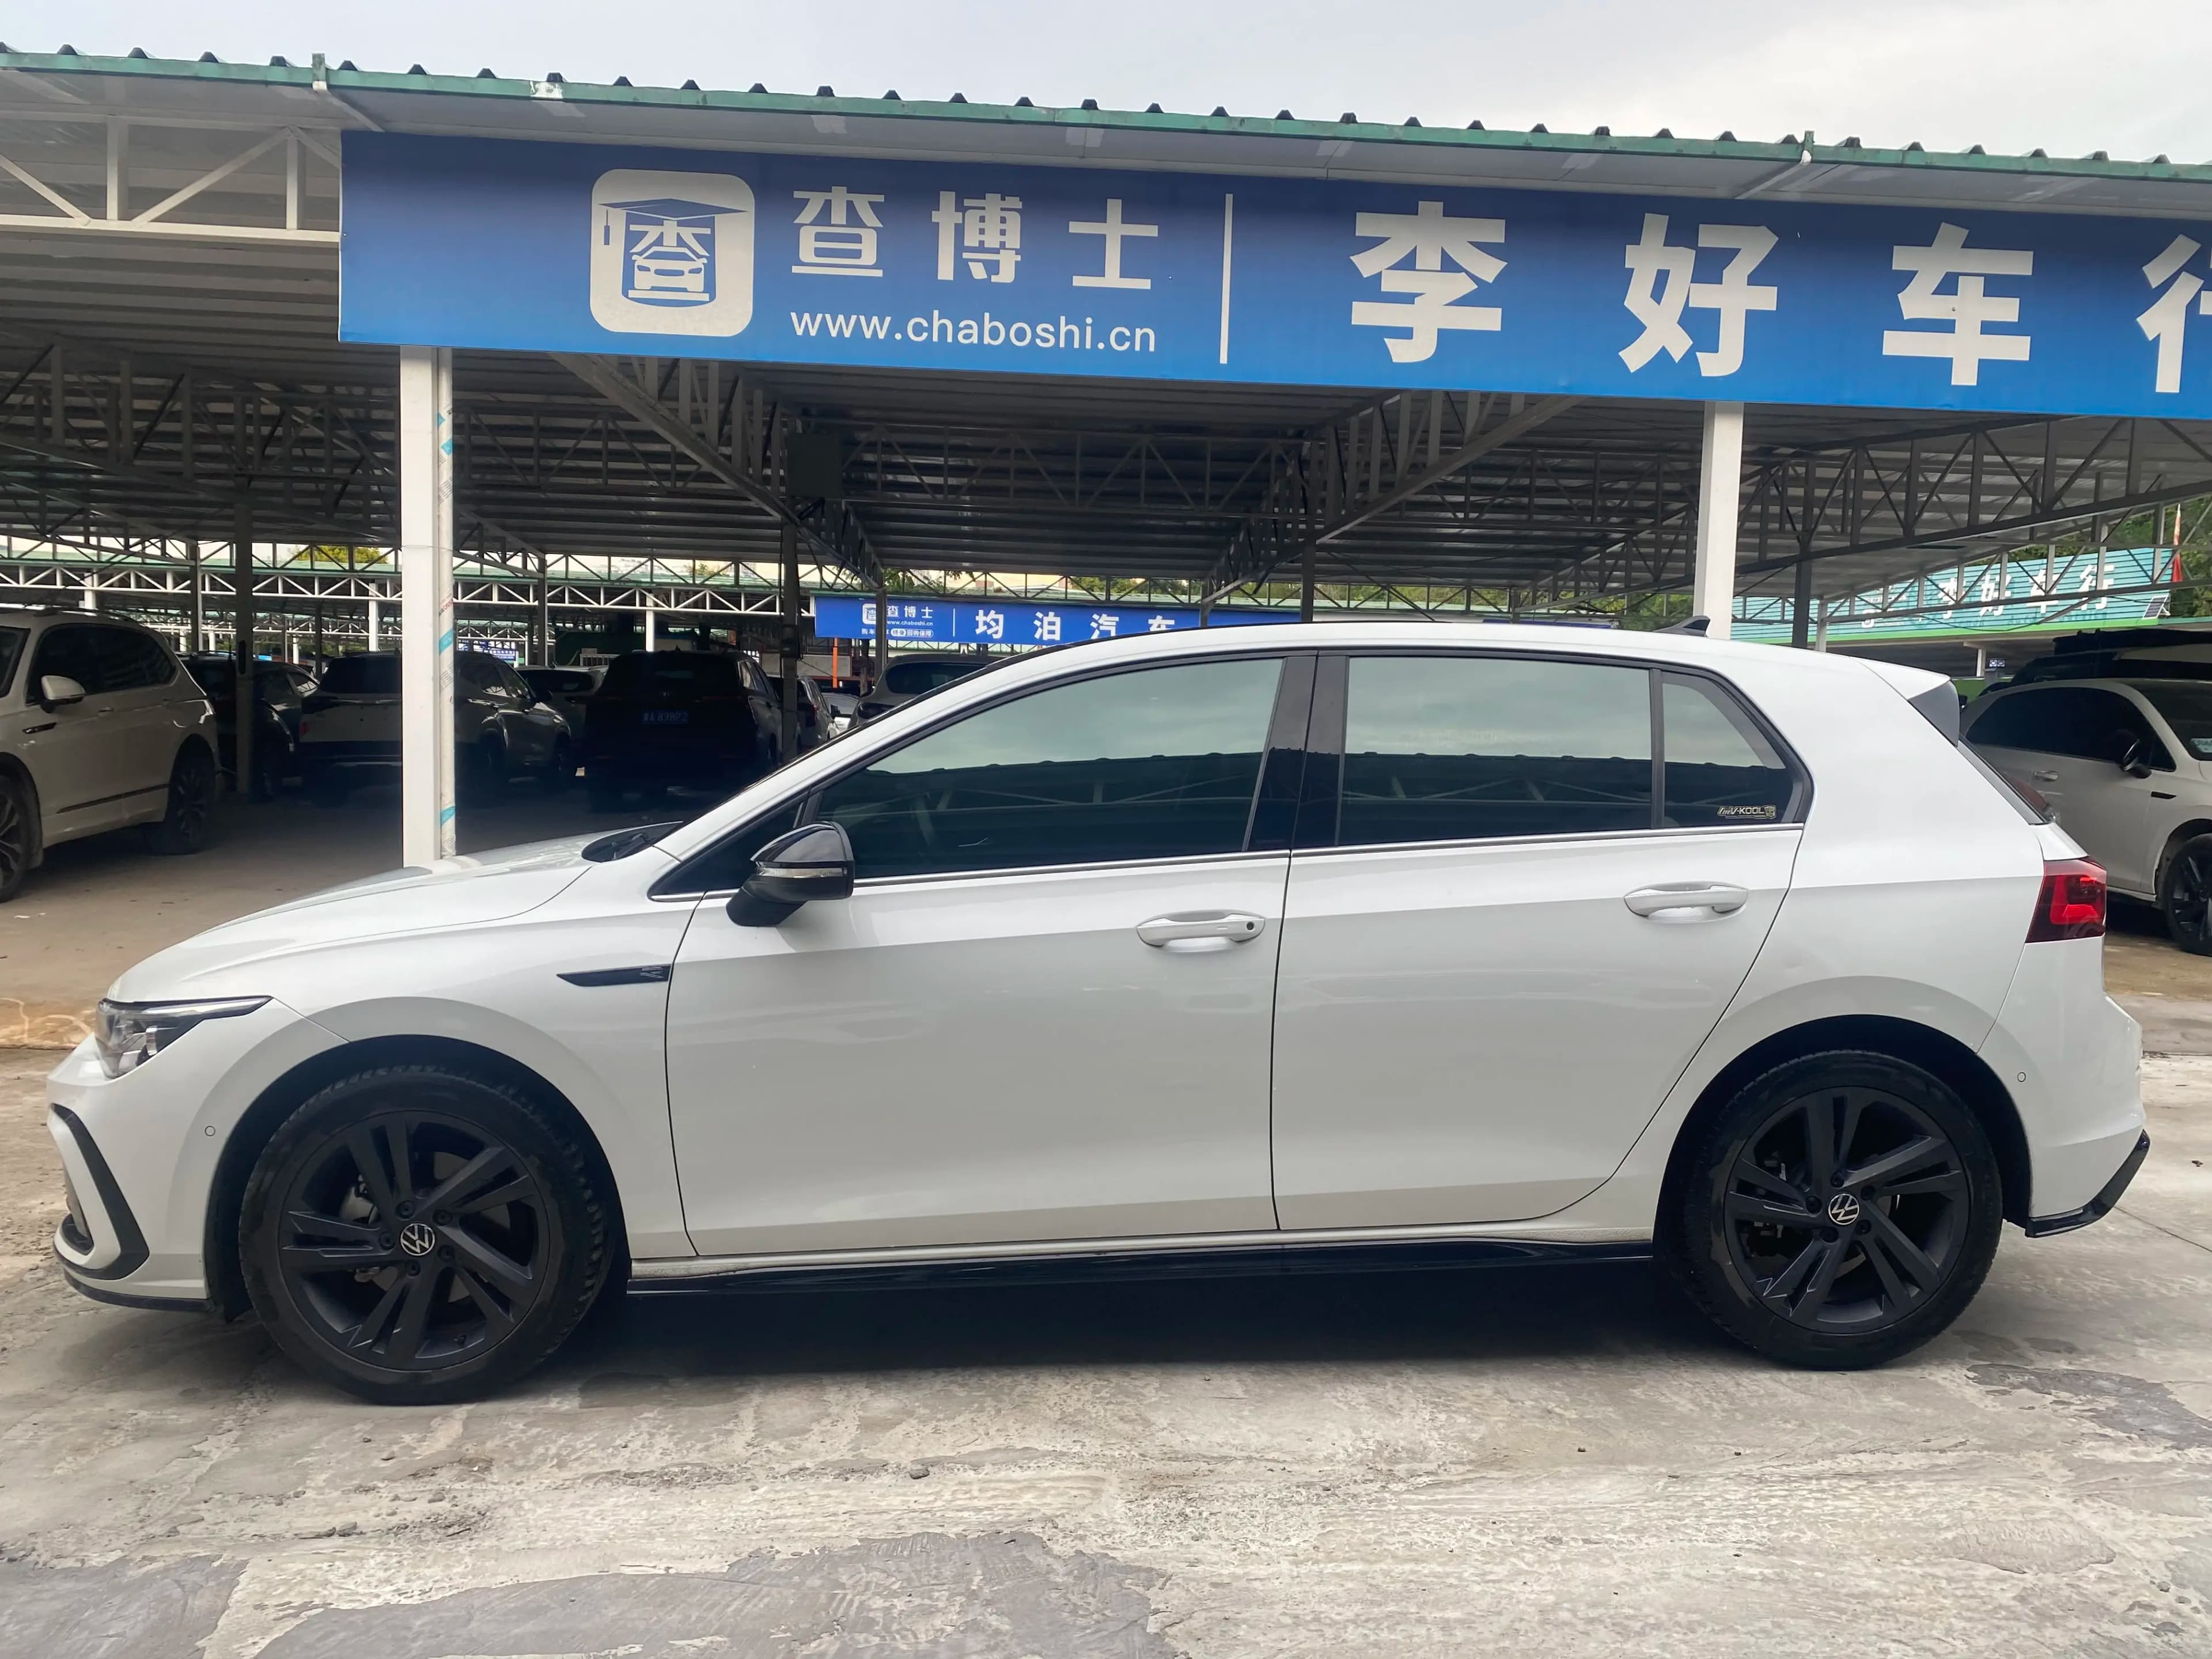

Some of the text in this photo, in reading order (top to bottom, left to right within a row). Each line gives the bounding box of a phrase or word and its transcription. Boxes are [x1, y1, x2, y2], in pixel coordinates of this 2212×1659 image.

[791, 185, 1159, 290] 查博士
[790, 309, 1156, 353] www.chaboshi.cn
[887, 605, 933, 618] 查博士
